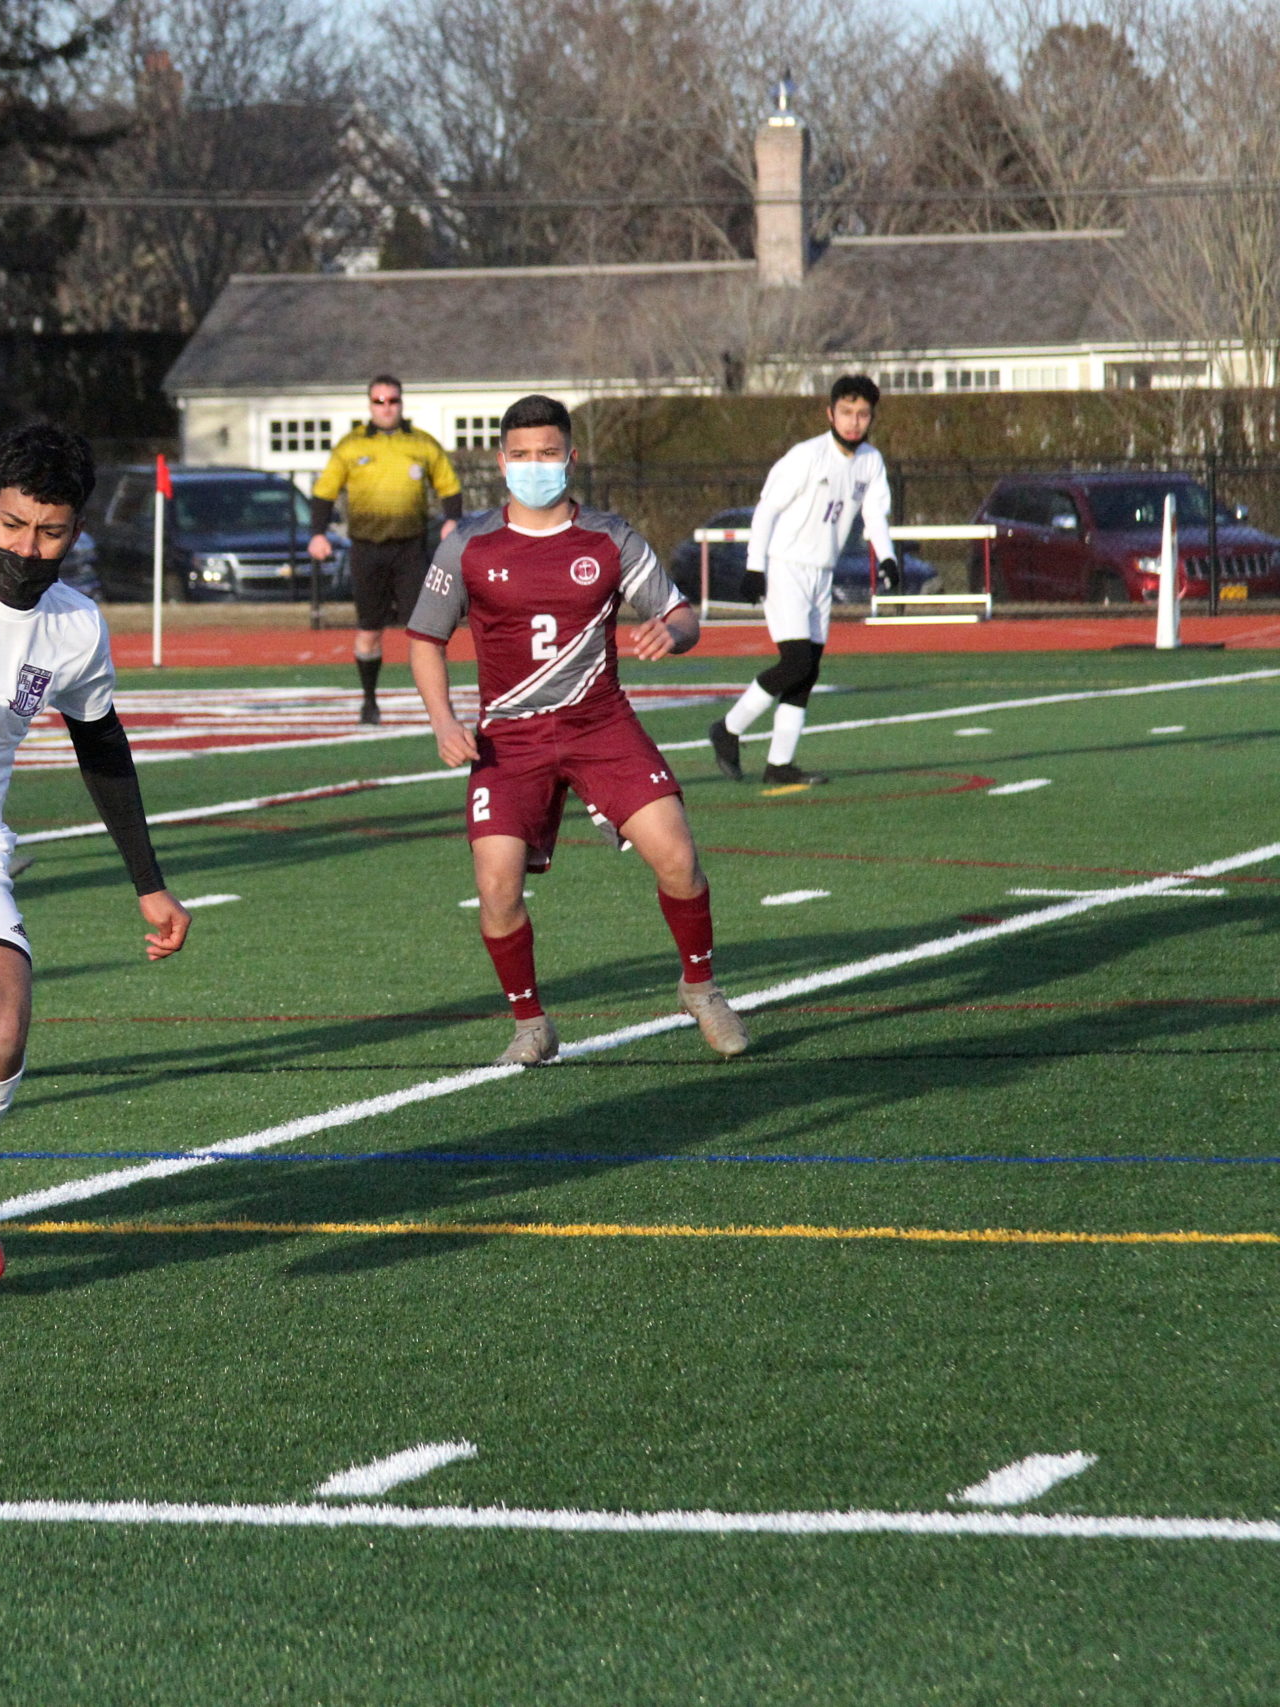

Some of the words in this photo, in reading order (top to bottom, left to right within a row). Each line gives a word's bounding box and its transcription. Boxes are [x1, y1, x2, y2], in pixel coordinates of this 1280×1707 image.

[823, 500, 844, 524] 13
[531, 614, 558, 660] 2
[473, 787, 490, 823] 2
